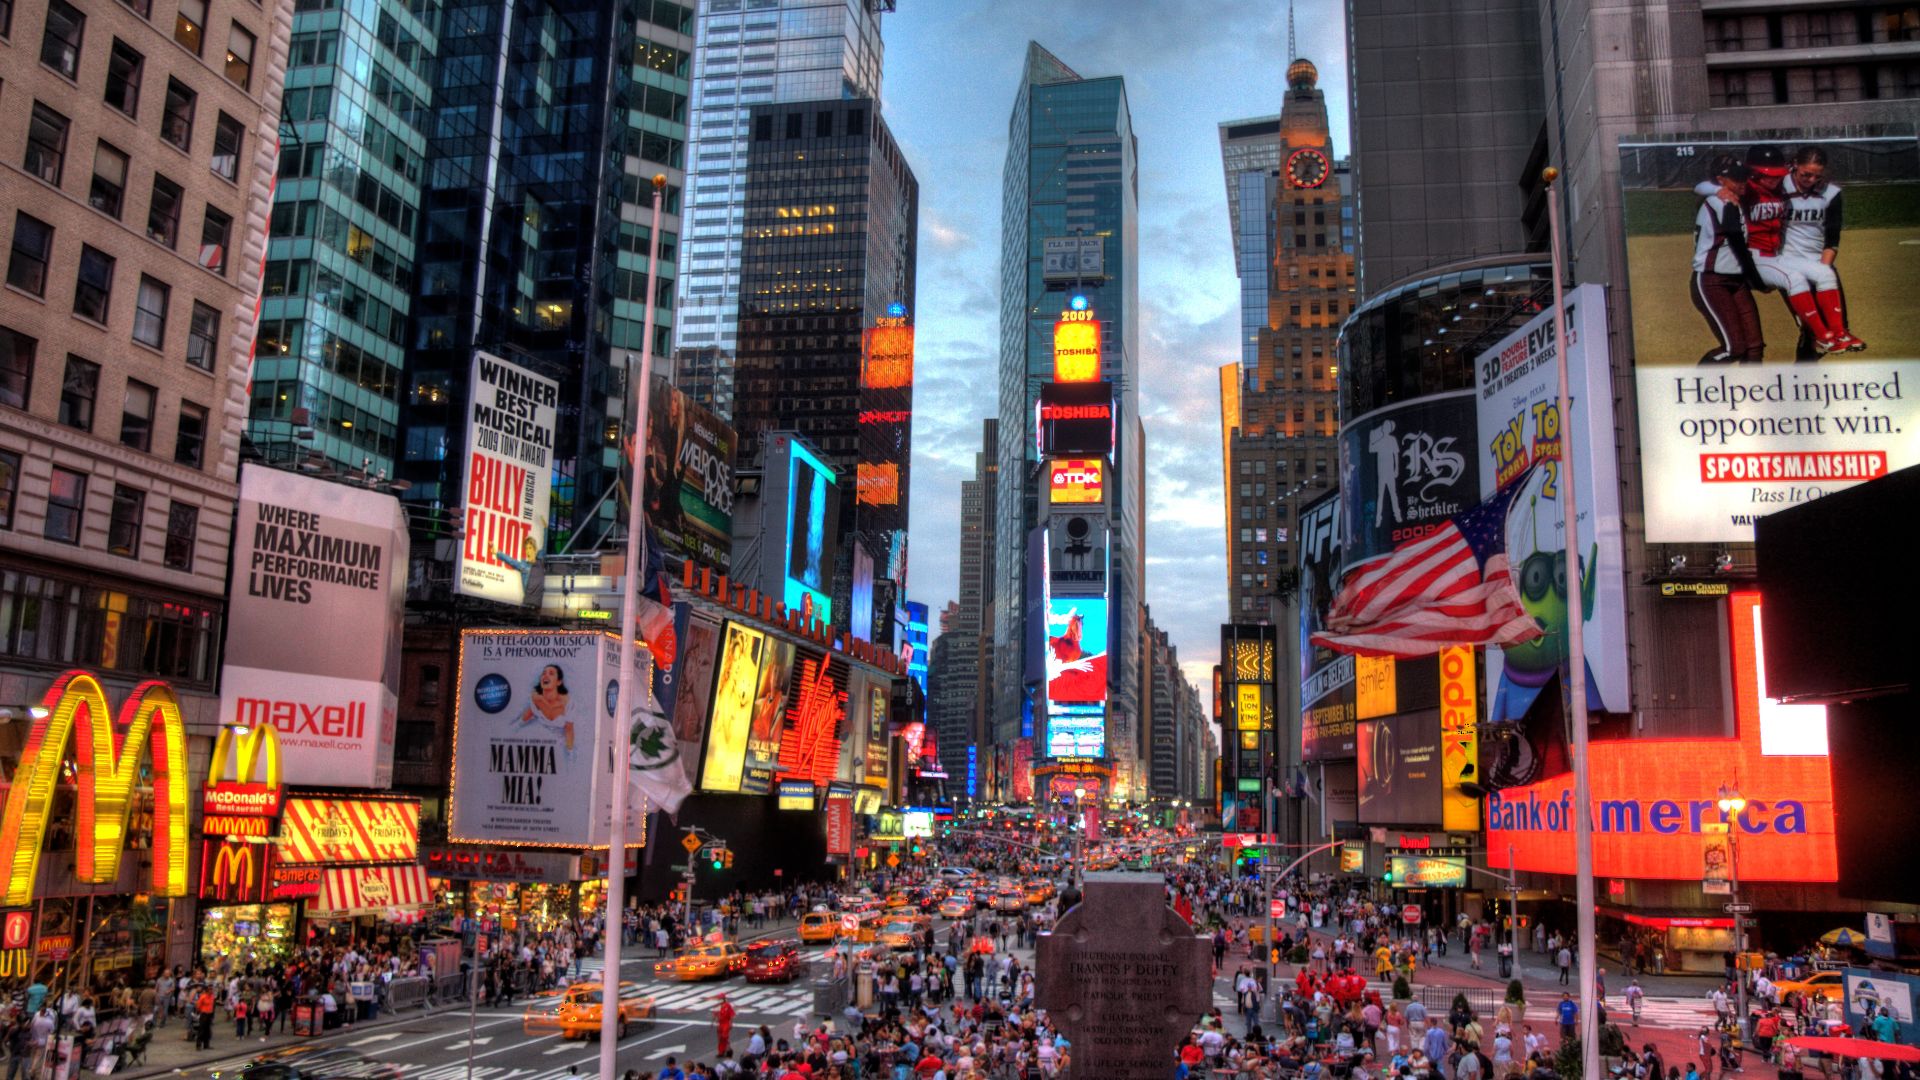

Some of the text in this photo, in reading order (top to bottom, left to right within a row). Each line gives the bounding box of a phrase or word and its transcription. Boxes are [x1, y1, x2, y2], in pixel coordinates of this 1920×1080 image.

[1787, 208, 1824, 222] ENTRA
[1061, 310, 1094, 322] 2009
[1056, 348, 1098, 356] TOSHIBA
[1482, 303, 1575, 386] 3D EVET
[1501, 335, 1527, 361] DOUBLE
[1502, 348, 1529, 374] FEATURE
[479, 358, 557, 409] WINNER
[1483, 382, 1496, 400] ONLY
[1504, 362, 1529, 388] THEATRES
[1530, 358, 1535, 371] 2
[1674, 371, 1903, 410] Helped injured
[495, 390, 539, 422] BEST
[1042, 406, 1111, 419] TOSHIBA
[474, 403, 552, 450] MUSICAL
[1490, 408, 1526, 470] TOY
[1680, 406, 1902, 444] opponent win.
[478, 426, 546, 468] 2009 TONY AWARD
[1535, 442, 1562, 458] STOR
[680, 439, 731, 487] MELROSE
[1499, 453, 1525, 487] STORY
[1705, 454, 1882, 480] SPORTSMANSHIP
[468, 452, 527, 518] BILLY
[1064, 472, 1099, 484] TDK
[1541, 458, 1557, 501] 2
[523, 470, 536, 520] THE MUSICAL
[704, 480, 733, 517] PLACE
[1751, 487, 1785, 503] Pass
[1789, 487, 1802, 503] It
[258, 502, 320, 532] WHERE
[254, 523, 381, 571] MAXIMUM
[463, 508, 533, 571] ELLIOT
[251, 551, 380, 590] PERFORMANCE
[1051, 572, 1104, 581] CHEVROLET
[249, 571, 312, 604] LIVES
[483, 647, 493, 657] IS
[493, 647, 503, 657] A
[496, 635, 551, 646] FEEL-GOOD
[553, 635, 597, 646] MUSICAL
[1360, 664, 1391, 695] smile?
[1240, 701, 1258, 712] LION
[1242, 693, 1256, 702] THE
[1442, 645, 1472, 758] odak
[236, 696, 366, 739] maxell
[1240, 713, 1259, 724] KING
[1312, 704, 1345, 726] SEPTEMBER
[1345, 702, 1354, 721] 19
[278, 736, 363, 750] ww.maxell.com
[489, 744, 557, 774] MAMMA
[205, 791, 276, 805] McDonald's
[501, 775, 543, 804] MIA!
[216, 804, 263, 813] Restaurant
[1489, 789, 1807, 834] Bank of merca
[429, 851, 527, 866] DIGITAL
[1416, 859, 1449, 869] WHITE
[1405, 869, 1462, 884] CHRISTMAS
[1070, 963, 1120, 975] FRANCIS
[1136, 965, 1179, 976] DUFFY
